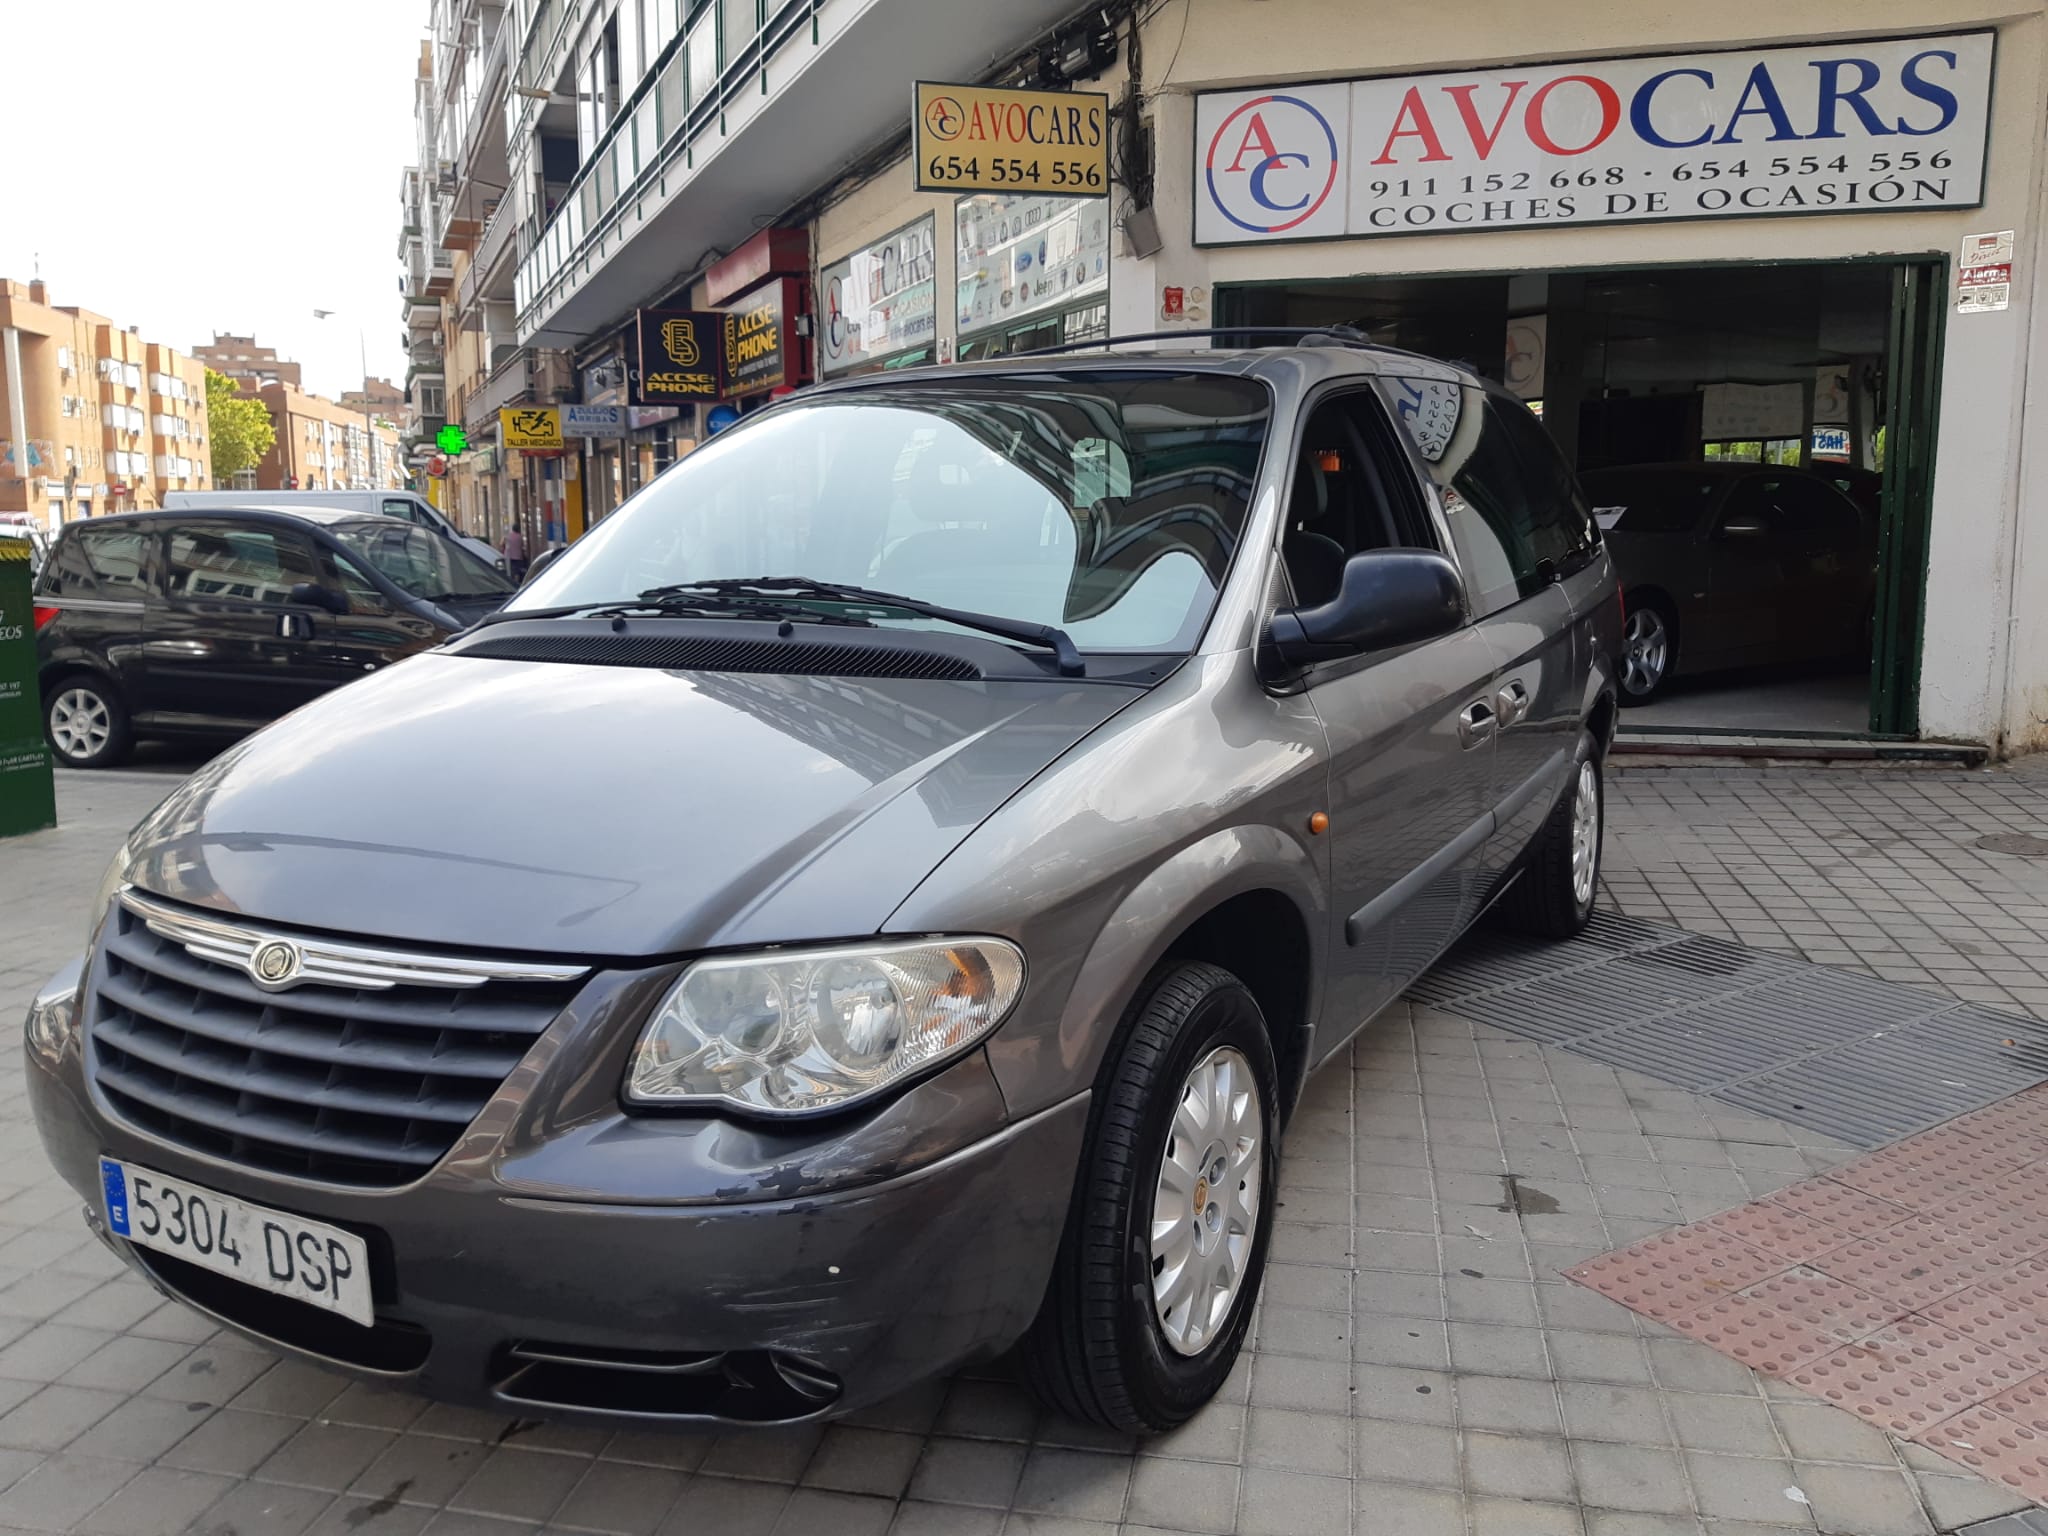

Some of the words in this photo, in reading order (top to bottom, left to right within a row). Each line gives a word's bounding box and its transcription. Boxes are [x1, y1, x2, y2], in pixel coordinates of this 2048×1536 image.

[967, 100, 1101, 148] AVOCARS
[1370, 50, 1959, 165] AVOCARS
[929, 155, 981, 181] 654
[990, 158, 1041, 184] 554
[1051, 161, 1101, 187] 556
[1225, 111, 1311, 211] AC
[1369, 177, 1438, 200] 911
[1460, 172, 1531, 194] 152
[1550, 166, 1625, 189] 668
[1671, 160, 1749, 182] 654
[1768, 154, 1849, 177] 554
[1868, 149, 1953, 173] 556
[1368, 196, 1577, 228] COCHES
[1603, 192, 1670, 216] DE
[1696, 174, 1952, 211] OCASIÓN
[1033, 277, 1054, 297] Jeep
[1963, 268, 2008, 279] Alarma
[738, 326, 778, 363] PHONE
[646, 382, 716, 394] PHONE
[506, 438, 528, 447] TALLER
[112, 1205, 124, 1224] E
[134, 1177, 242, 1267] 5304
[263, 1221, 352, 1301] DSP
